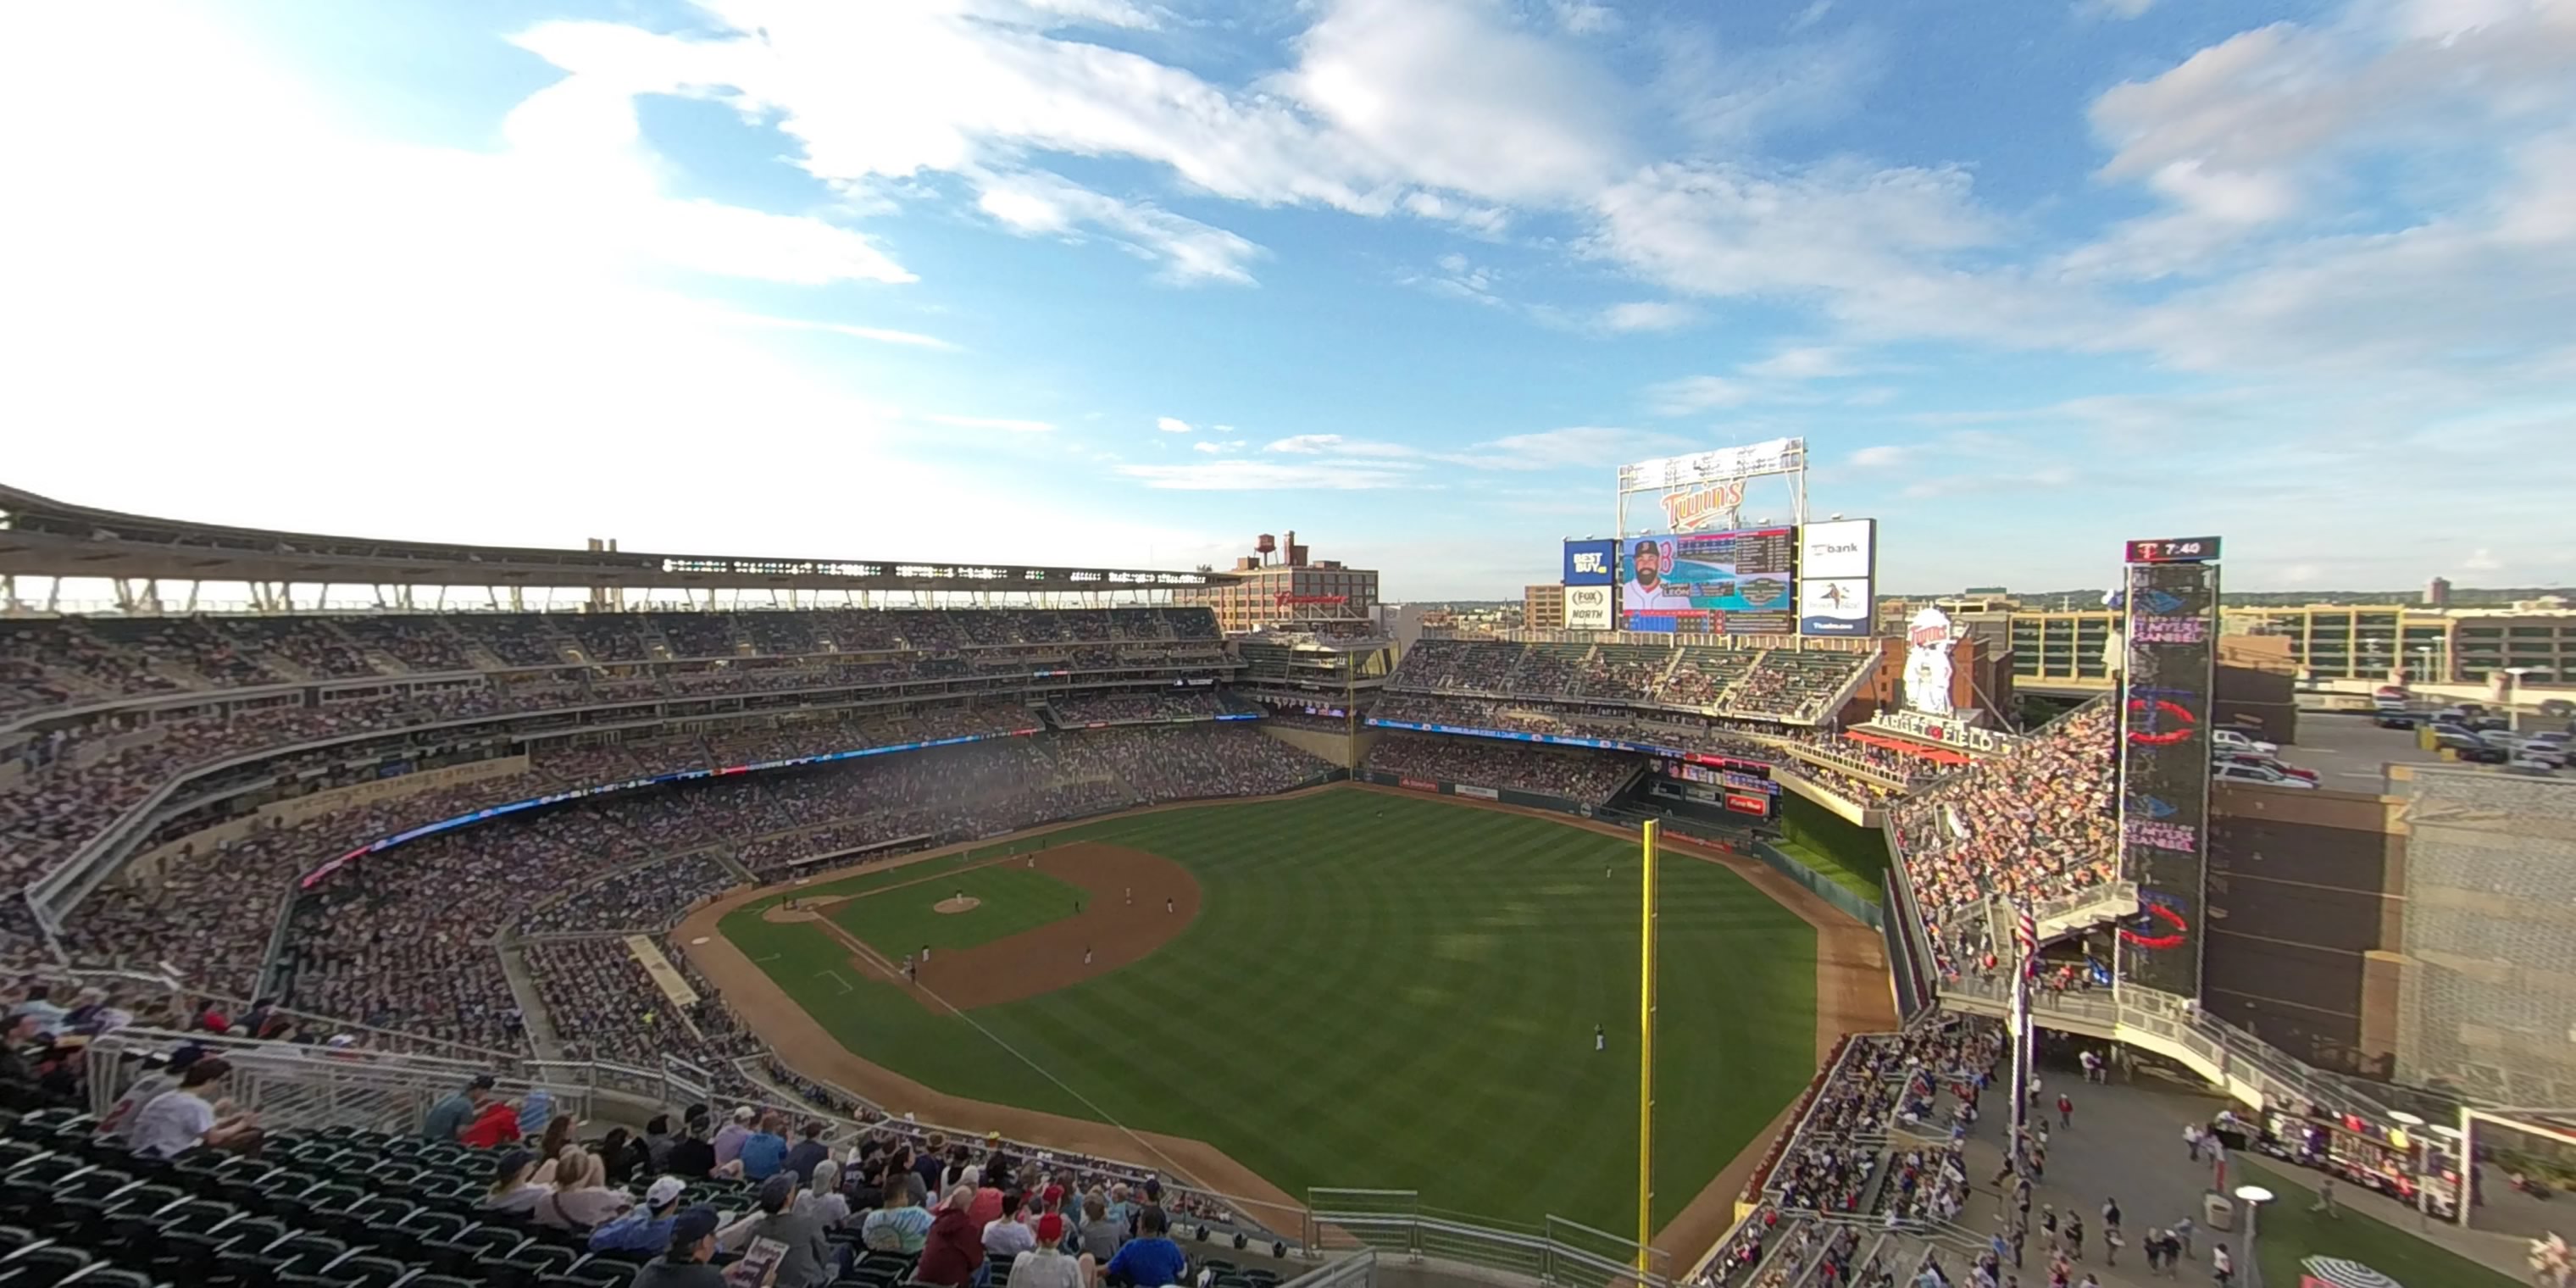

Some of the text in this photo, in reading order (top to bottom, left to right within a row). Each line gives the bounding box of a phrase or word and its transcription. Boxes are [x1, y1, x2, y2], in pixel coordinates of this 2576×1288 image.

[1662, 480, 1743, 528] Twins
[2165, 542, 2201, 554] 7:40
[1574, 552, 1603, 564] BEST
[1575, 563, 1600, 573] BUY
[1578, 591, 1597, 601] FOX
[1573, 610, 1603, 619] NORTH
[1944, 728, 1993, 752] FIELD
